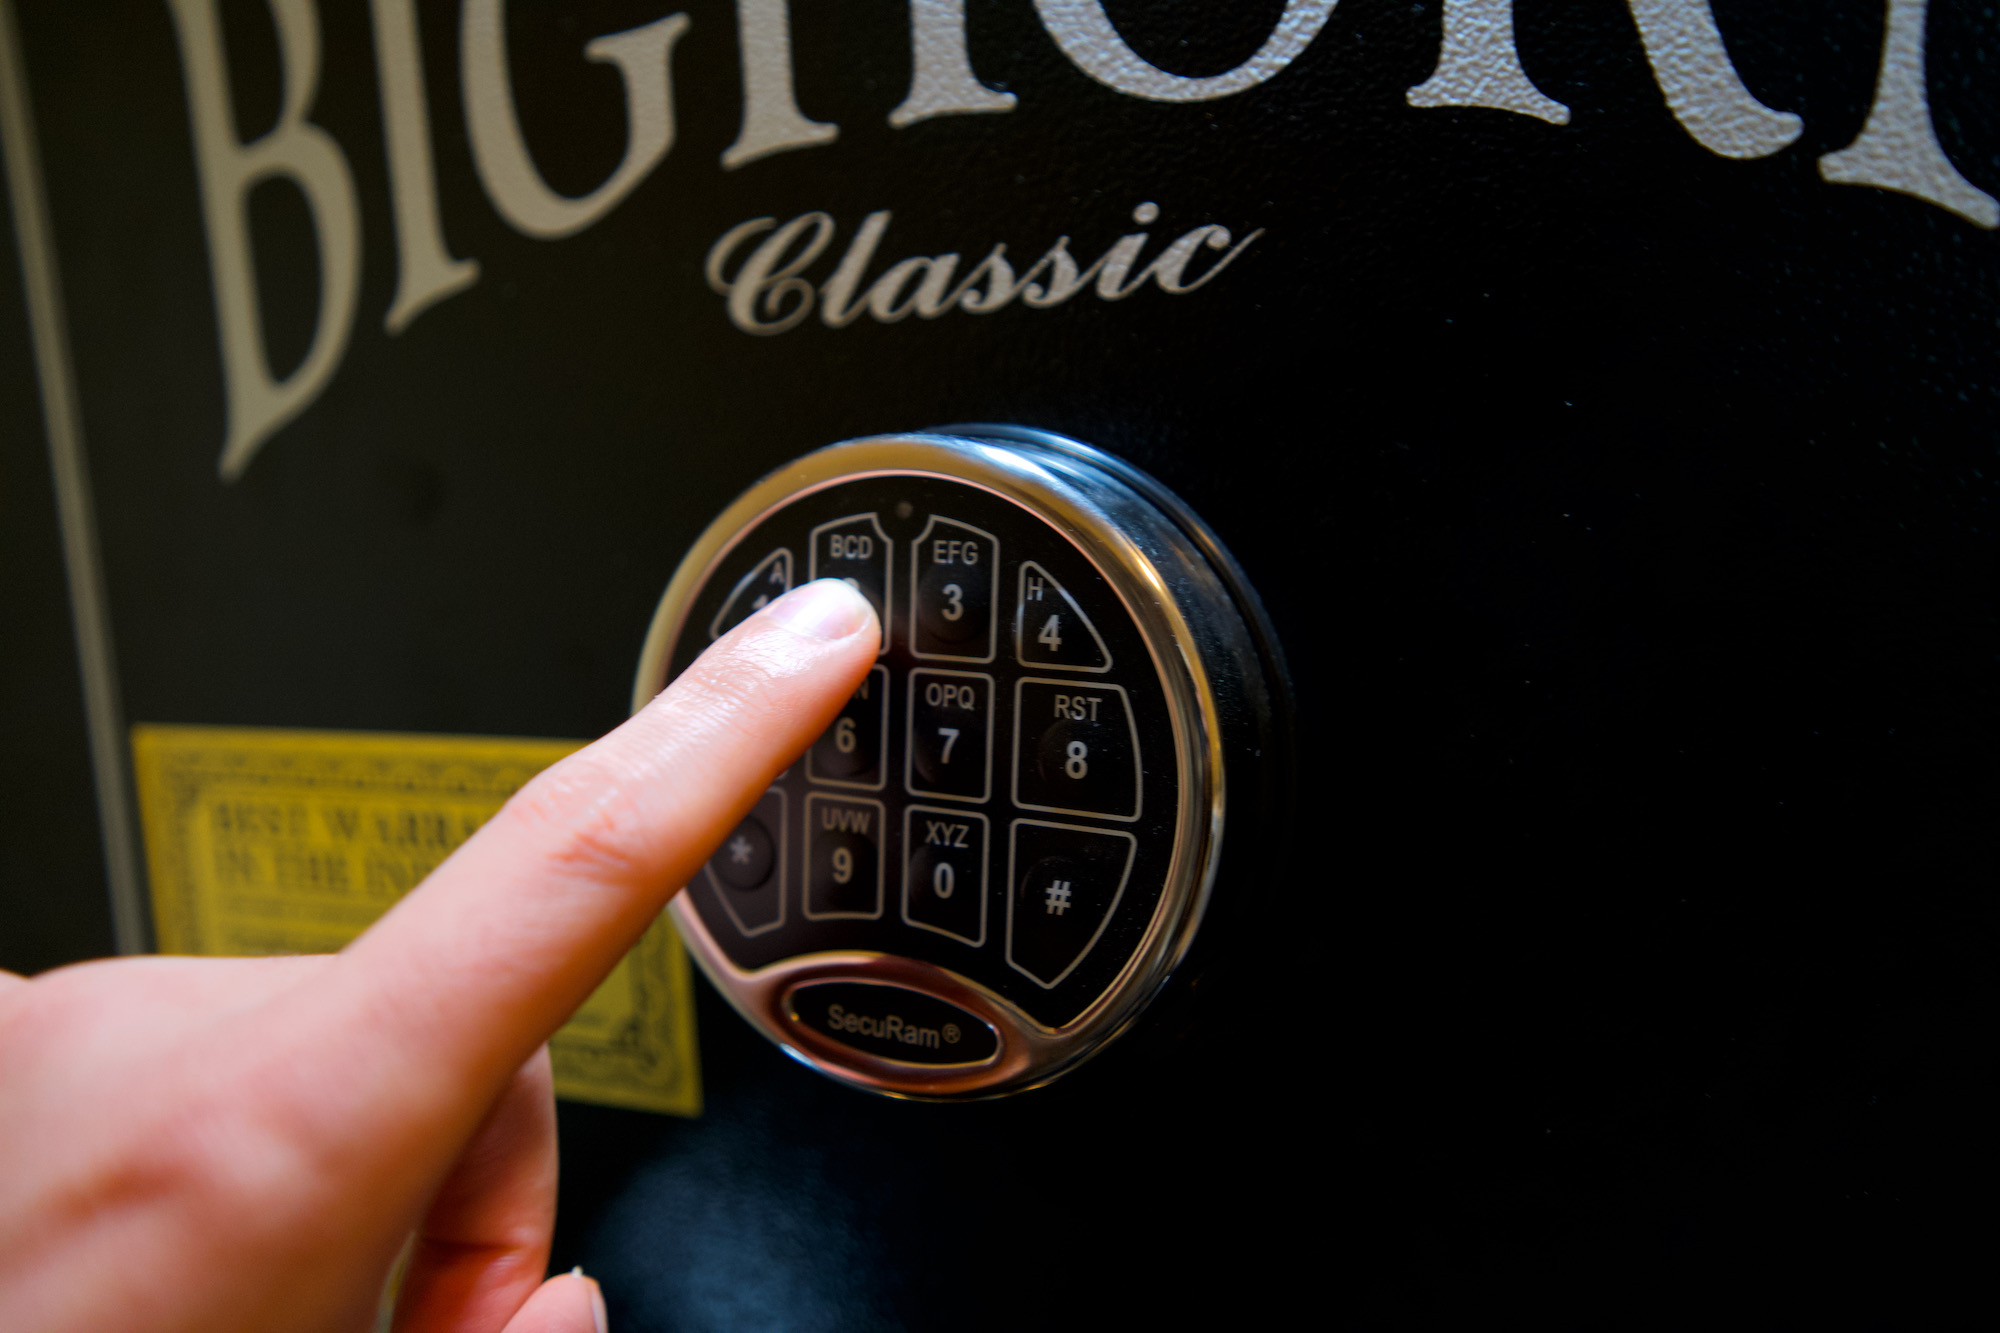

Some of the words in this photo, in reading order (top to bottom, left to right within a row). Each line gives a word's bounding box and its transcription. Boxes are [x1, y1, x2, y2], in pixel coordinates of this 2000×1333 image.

[705, 202, 1265, 336] Classic
[830, 535, 873, 559] BCD
[933, 540, 979, 565] EFG
[769, 561, 786, 585] A
[1027, 577, 1044, 601] H
[942, 583, 964, 621] 3
[1037, 614, 1063, 652] 4
[925, 682, 976, 711] OPQ
[1054, 694, 1103, 722] RST
[835, 717, 856, 754] 6
[938, 727, 960, 764] 7
[1065, 740, 1089, 780] 8
[821, 806, 871, 834] UVW
[925, 820, 970, 848] XYZ
[832, 847, 853, 884] 9
[933, 862, 955, 899] 0
[1045, 879, 1072, 916] #
